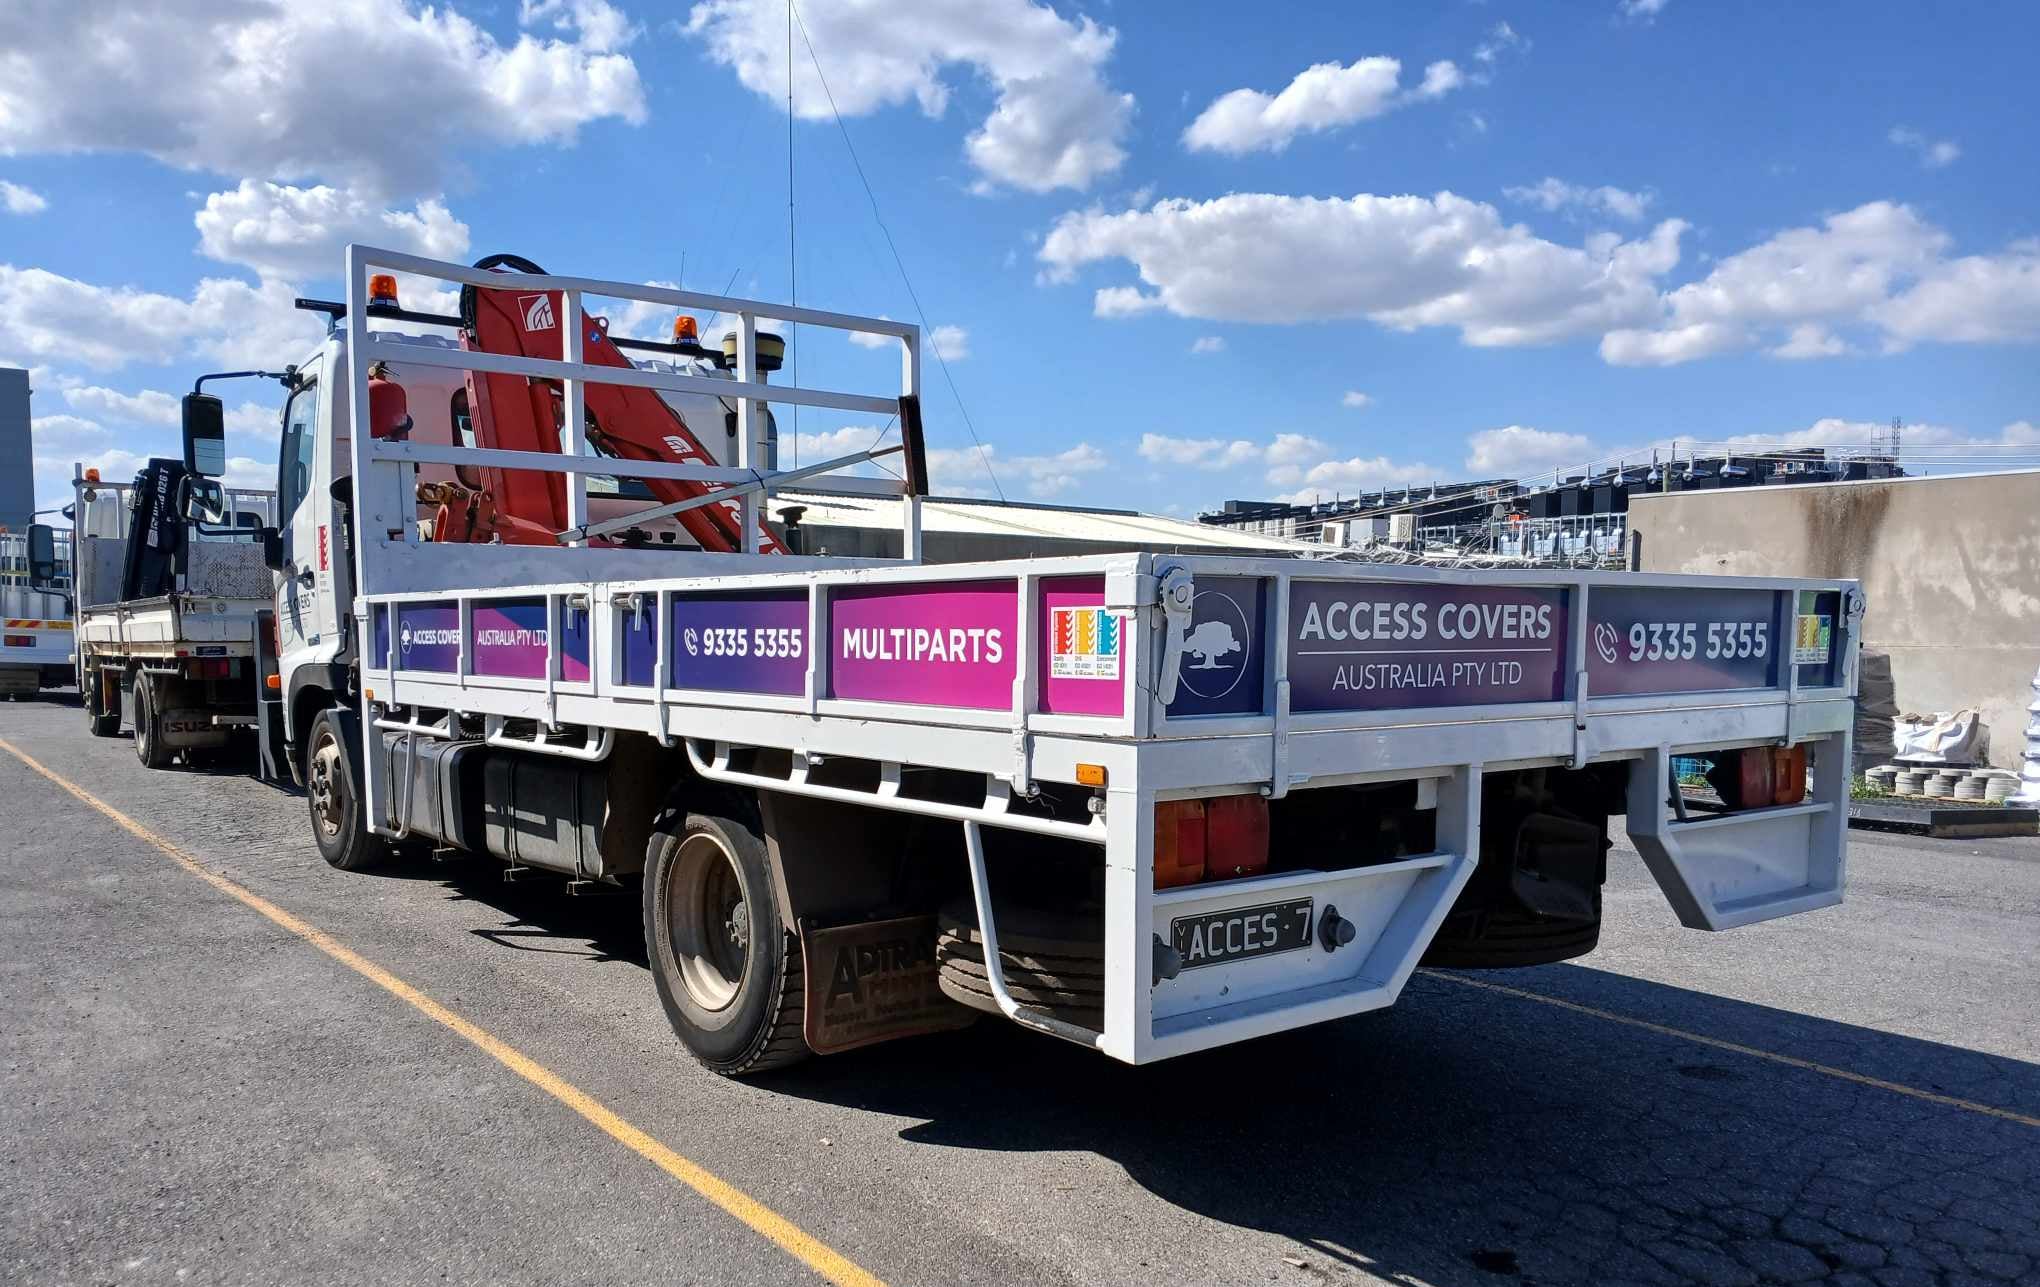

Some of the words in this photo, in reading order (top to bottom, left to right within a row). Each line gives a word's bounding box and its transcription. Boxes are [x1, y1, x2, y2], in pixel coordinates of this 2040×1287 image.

[412, 629, 437, 645] ACCESS
[437, 629, 460, 645] COVER
[1299, 602, 1428, 640] ACCESS
[1437, 603, 1552, 640] COVERS
[477, 629, 516, 646] AUSTRALIA
[516, 629, 532, 646] PTY
[532, 629, 548, 647] LTD
[703, 628, 748, 657] 9335
[753, 628, 802, 658] 5355
[843, 628, 1003, 664] MULTIPARTS
[1628, 622, 1697, 662] 9335
[1706, 622, 1768, 660] 5355
[1332, 663, 1447, 691] AUSTRALIA
[1452, 662, 1486, 687] PTY
[1491, 661, 1522, 686] LTD
[1188, 912, 1278, 962] ACCES
[1296, 907, 1312, 941] 7
